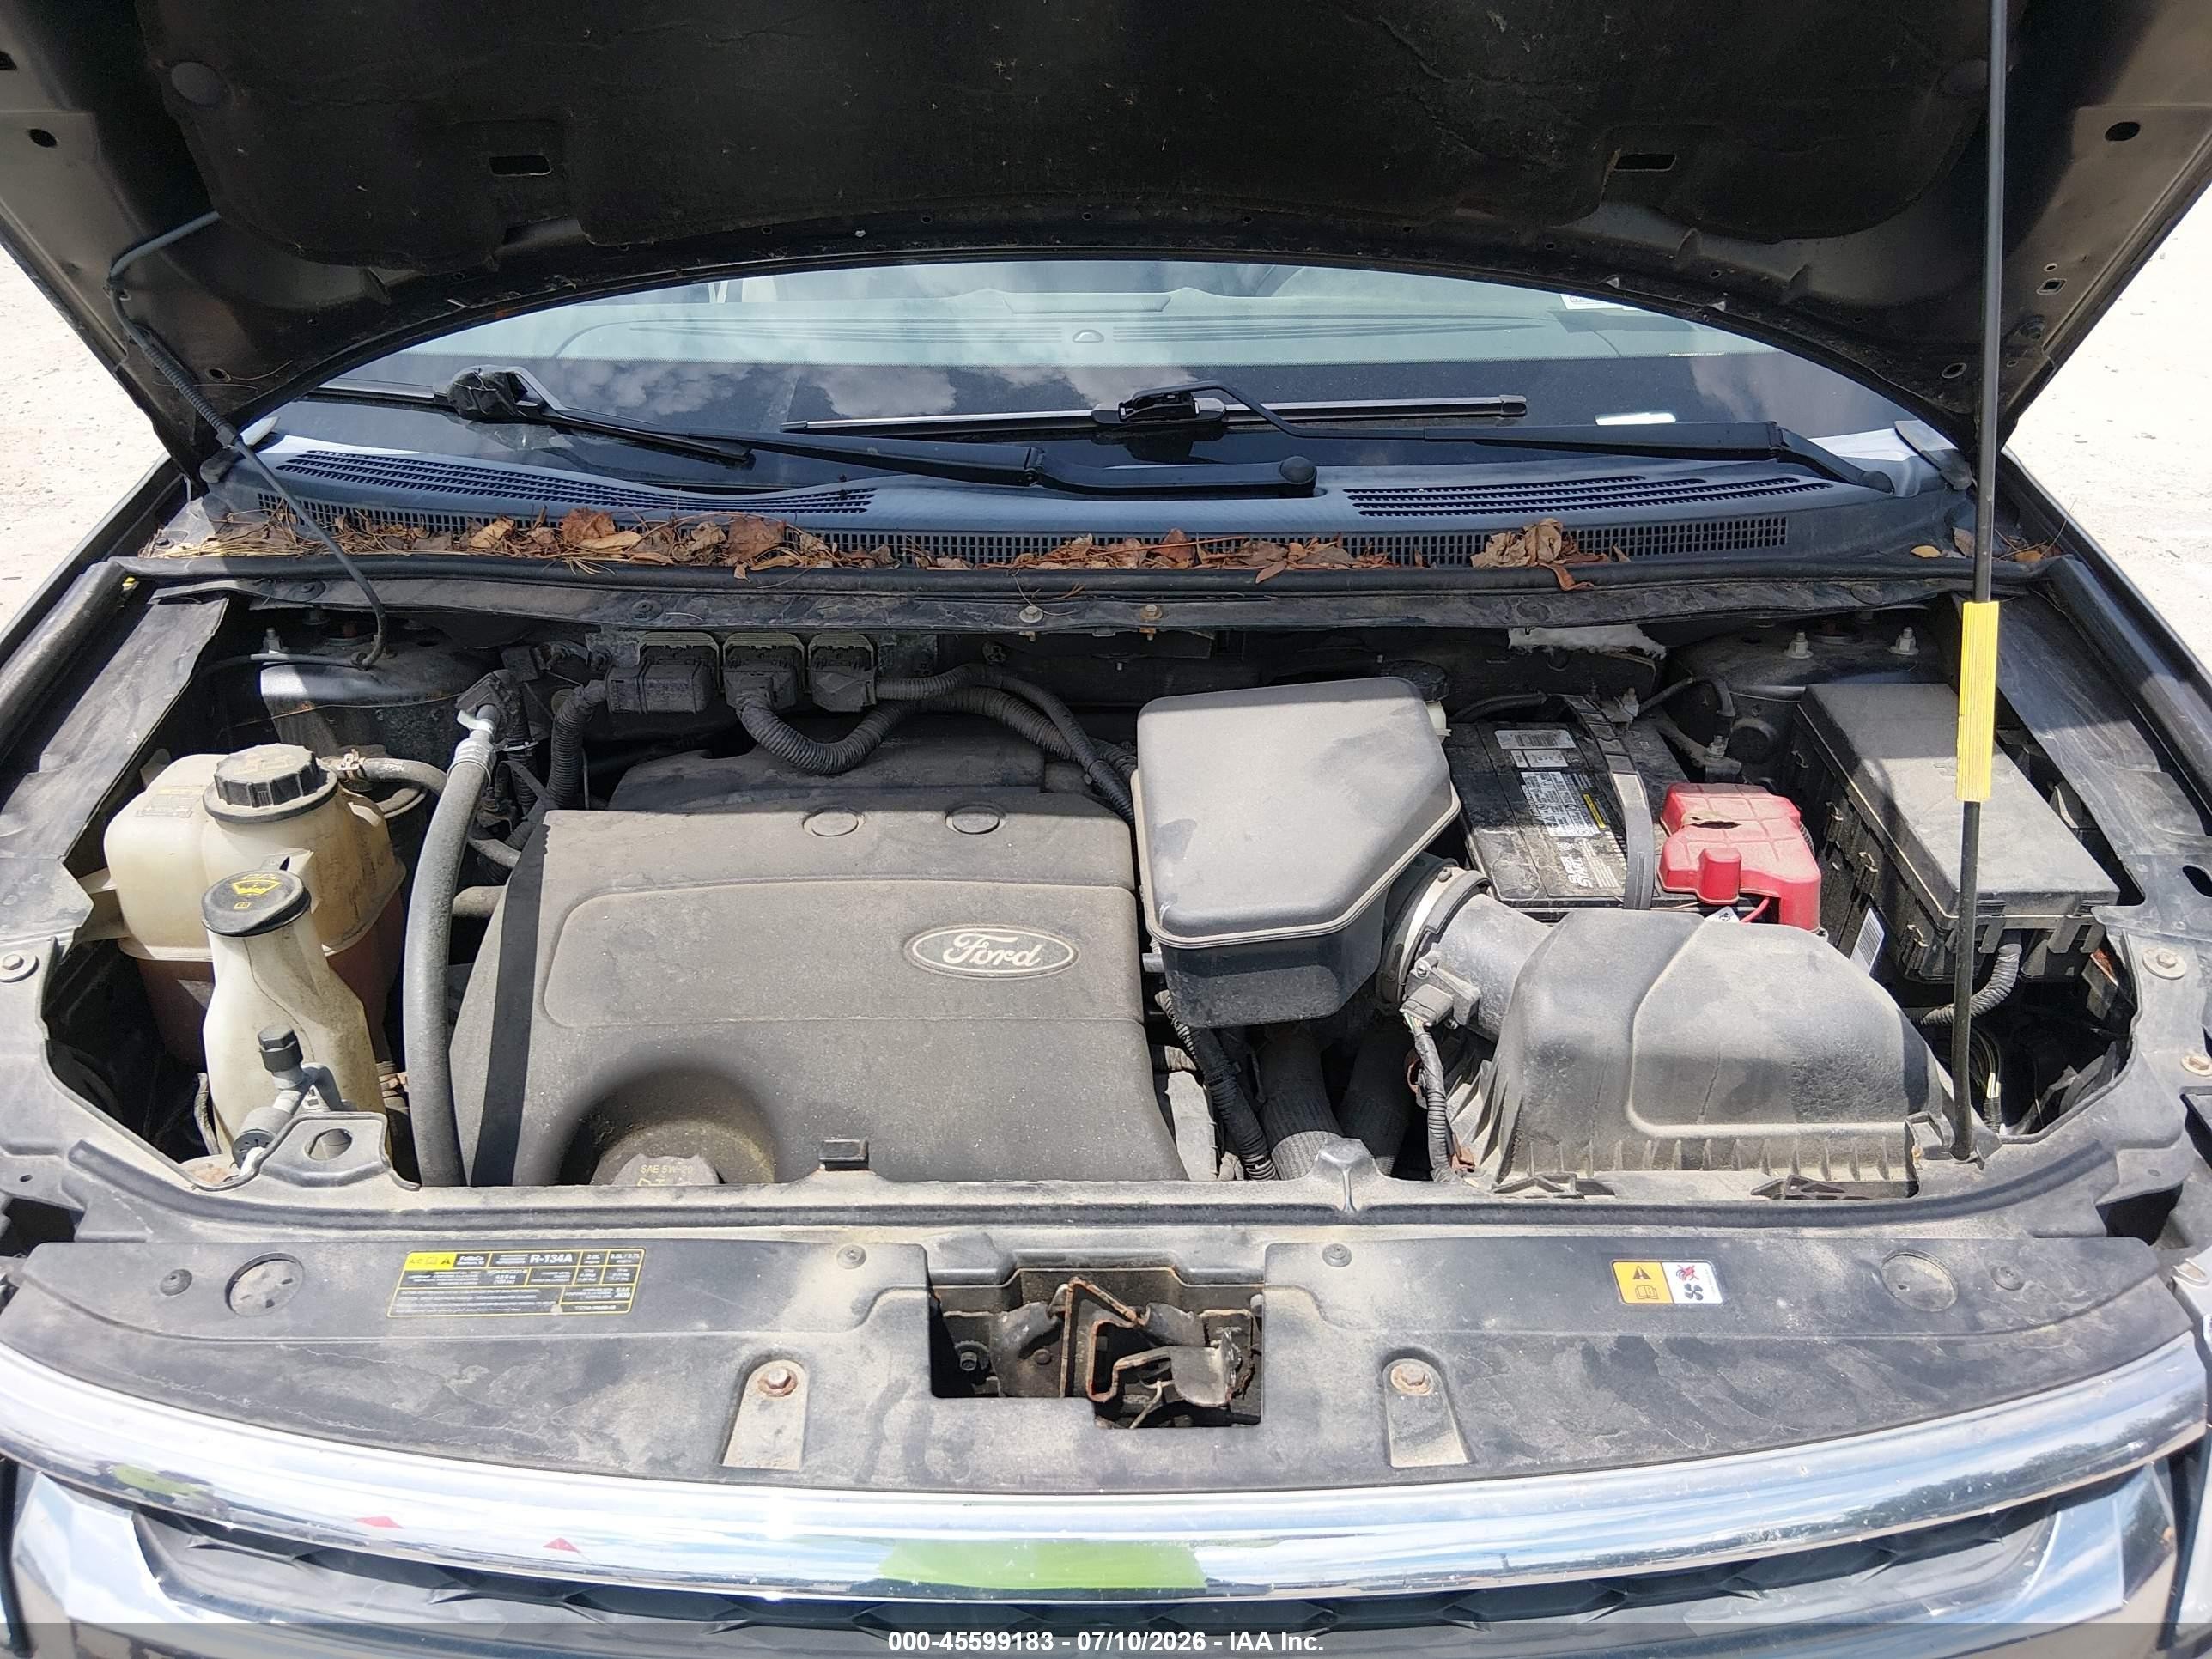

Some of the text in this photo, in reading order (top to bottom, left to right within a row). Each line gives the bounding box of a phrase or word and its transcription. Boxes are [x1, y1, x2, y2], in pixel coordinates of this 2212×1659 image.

[943, 933, 1045, 966] Ford
[640, 1164, 694, 1175] SAE 5W-20
[529, 1253, 574, 1264] R-134A
